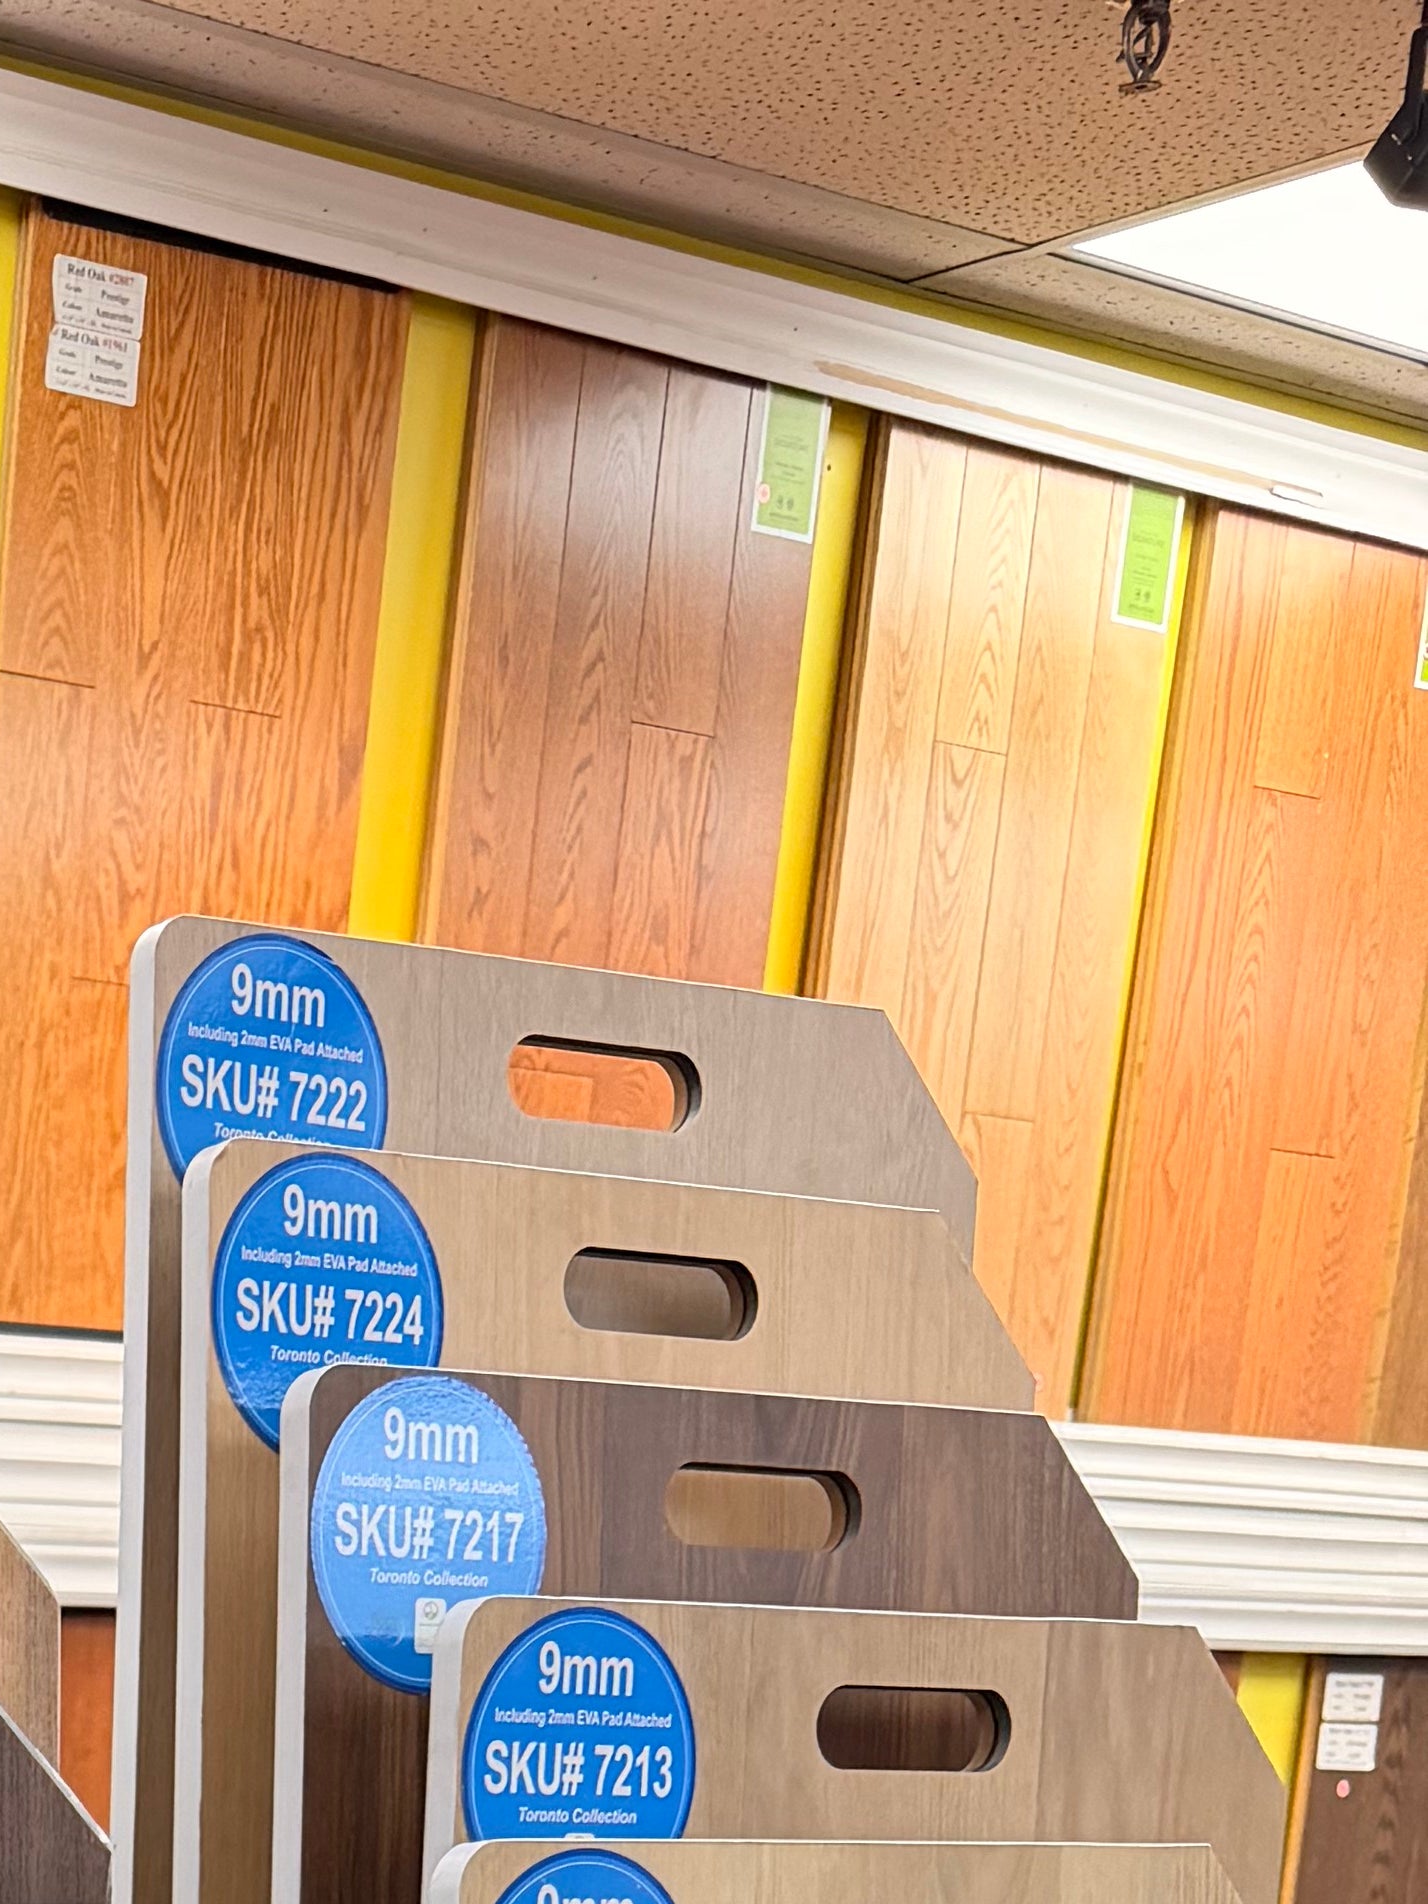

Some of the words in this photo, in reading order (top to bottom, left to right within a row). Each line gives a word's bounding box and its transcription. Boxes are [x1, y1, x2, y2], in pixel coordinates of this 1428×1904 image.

[231, 963, 325, 1028] 9mm
[180, 1054, 280, 1119] SKU#
[289, 1071, 367, 1132] 7222
[283, 1183, 378, 1244] 9mm
[236, 1277, 335, 1338] SKU#
[344, 1289, 424, 1346] 7224
[383, 1406, 479, 1464] 9mm
[335, 1502, 435, 1560] SKU#
[443, 1508, 525, 1563] 7217
[538, 1640, 634, 1697] 9mm
[494, 1707, 546, 1728] Including
[548, 1709, 575, 1725] 2mm
[576, 1709, 600, 1725] EVA
[601, 1710, 623, 1726] Pad
[623, 1711, 672, 1728] Attached
[483, 1739, 585, 1796] SKU#
[594, 1744, 673, 1798] 7213
[519, 1806, 569, 1823] Toronto
[572, 1807, 637, 1824] Collection
